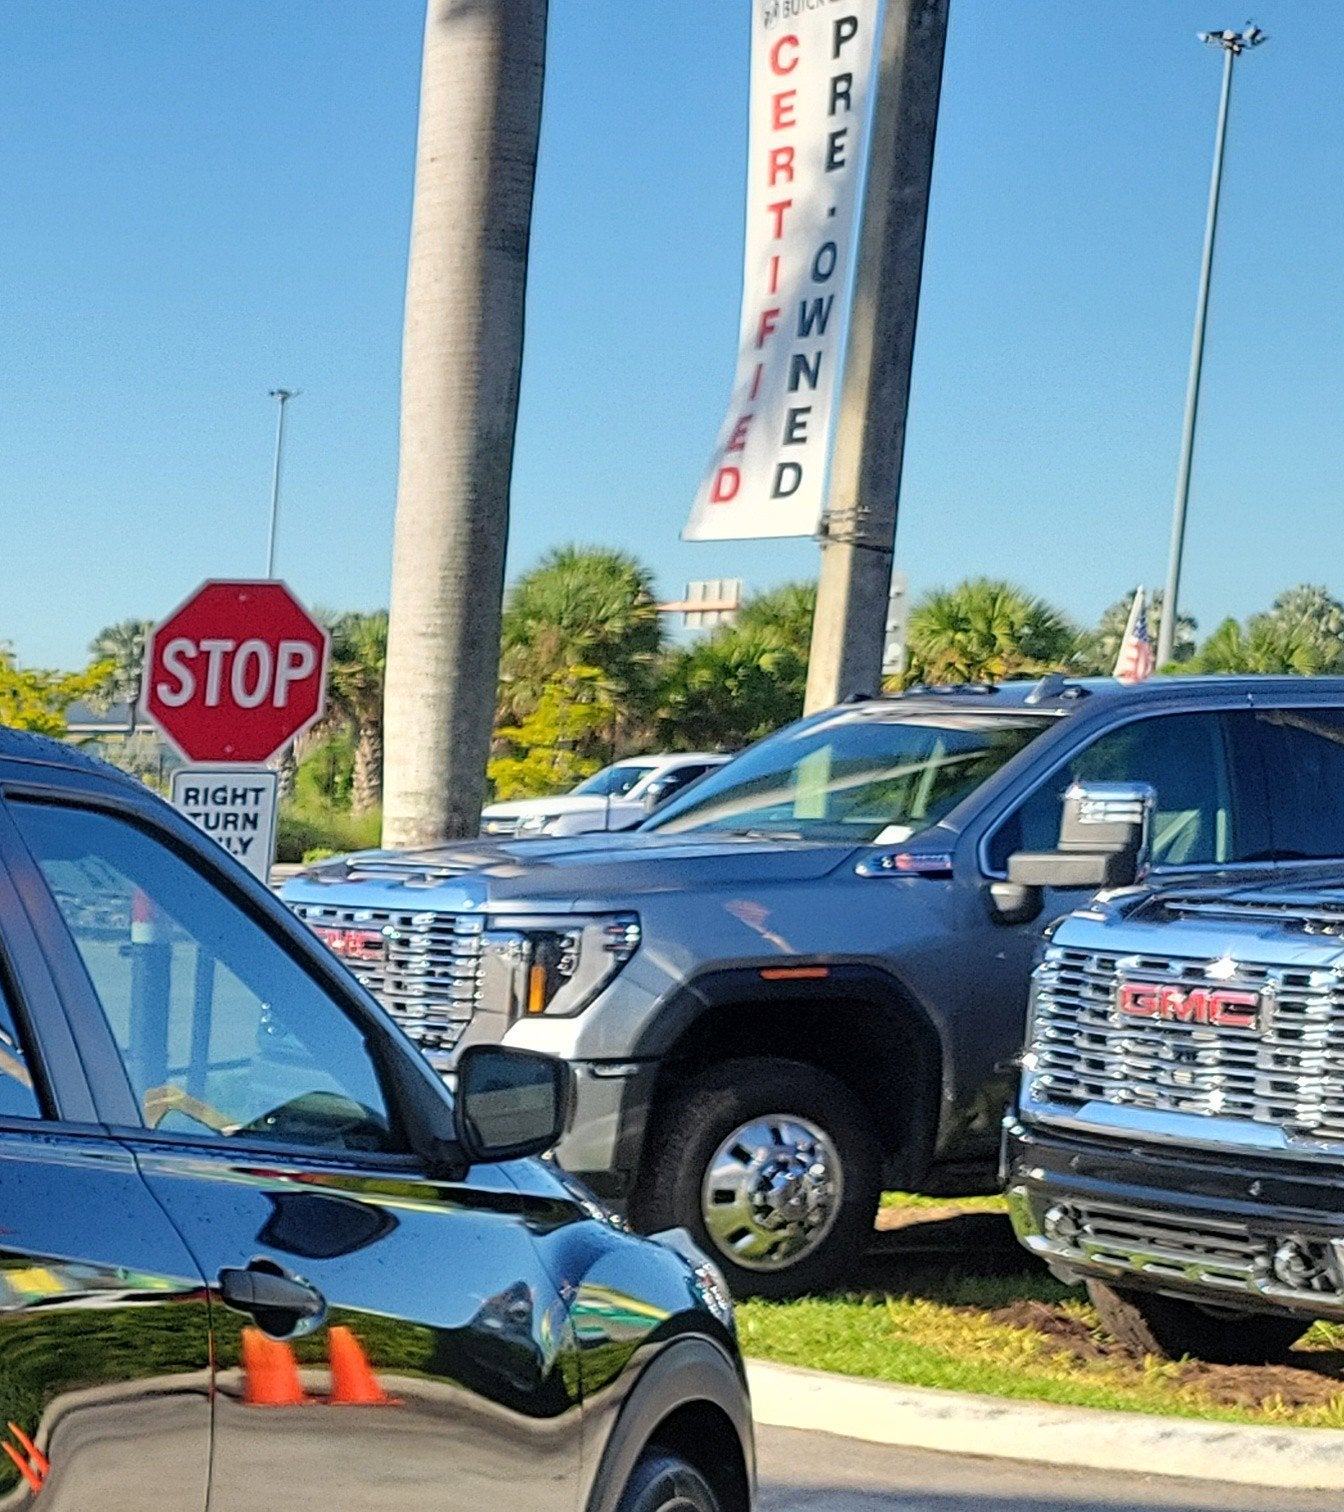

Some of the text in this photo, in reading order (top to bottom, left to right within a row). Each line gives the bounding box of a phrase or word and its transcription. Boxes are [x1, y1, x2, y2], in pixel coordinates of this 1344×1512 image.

[712, 34, 799, 503] CERTIFIED
[156, 637, 315, 709] STOP
[184, 786, 265, 806] RIGHT
[1120, 983, 1260, 1028] GMC
